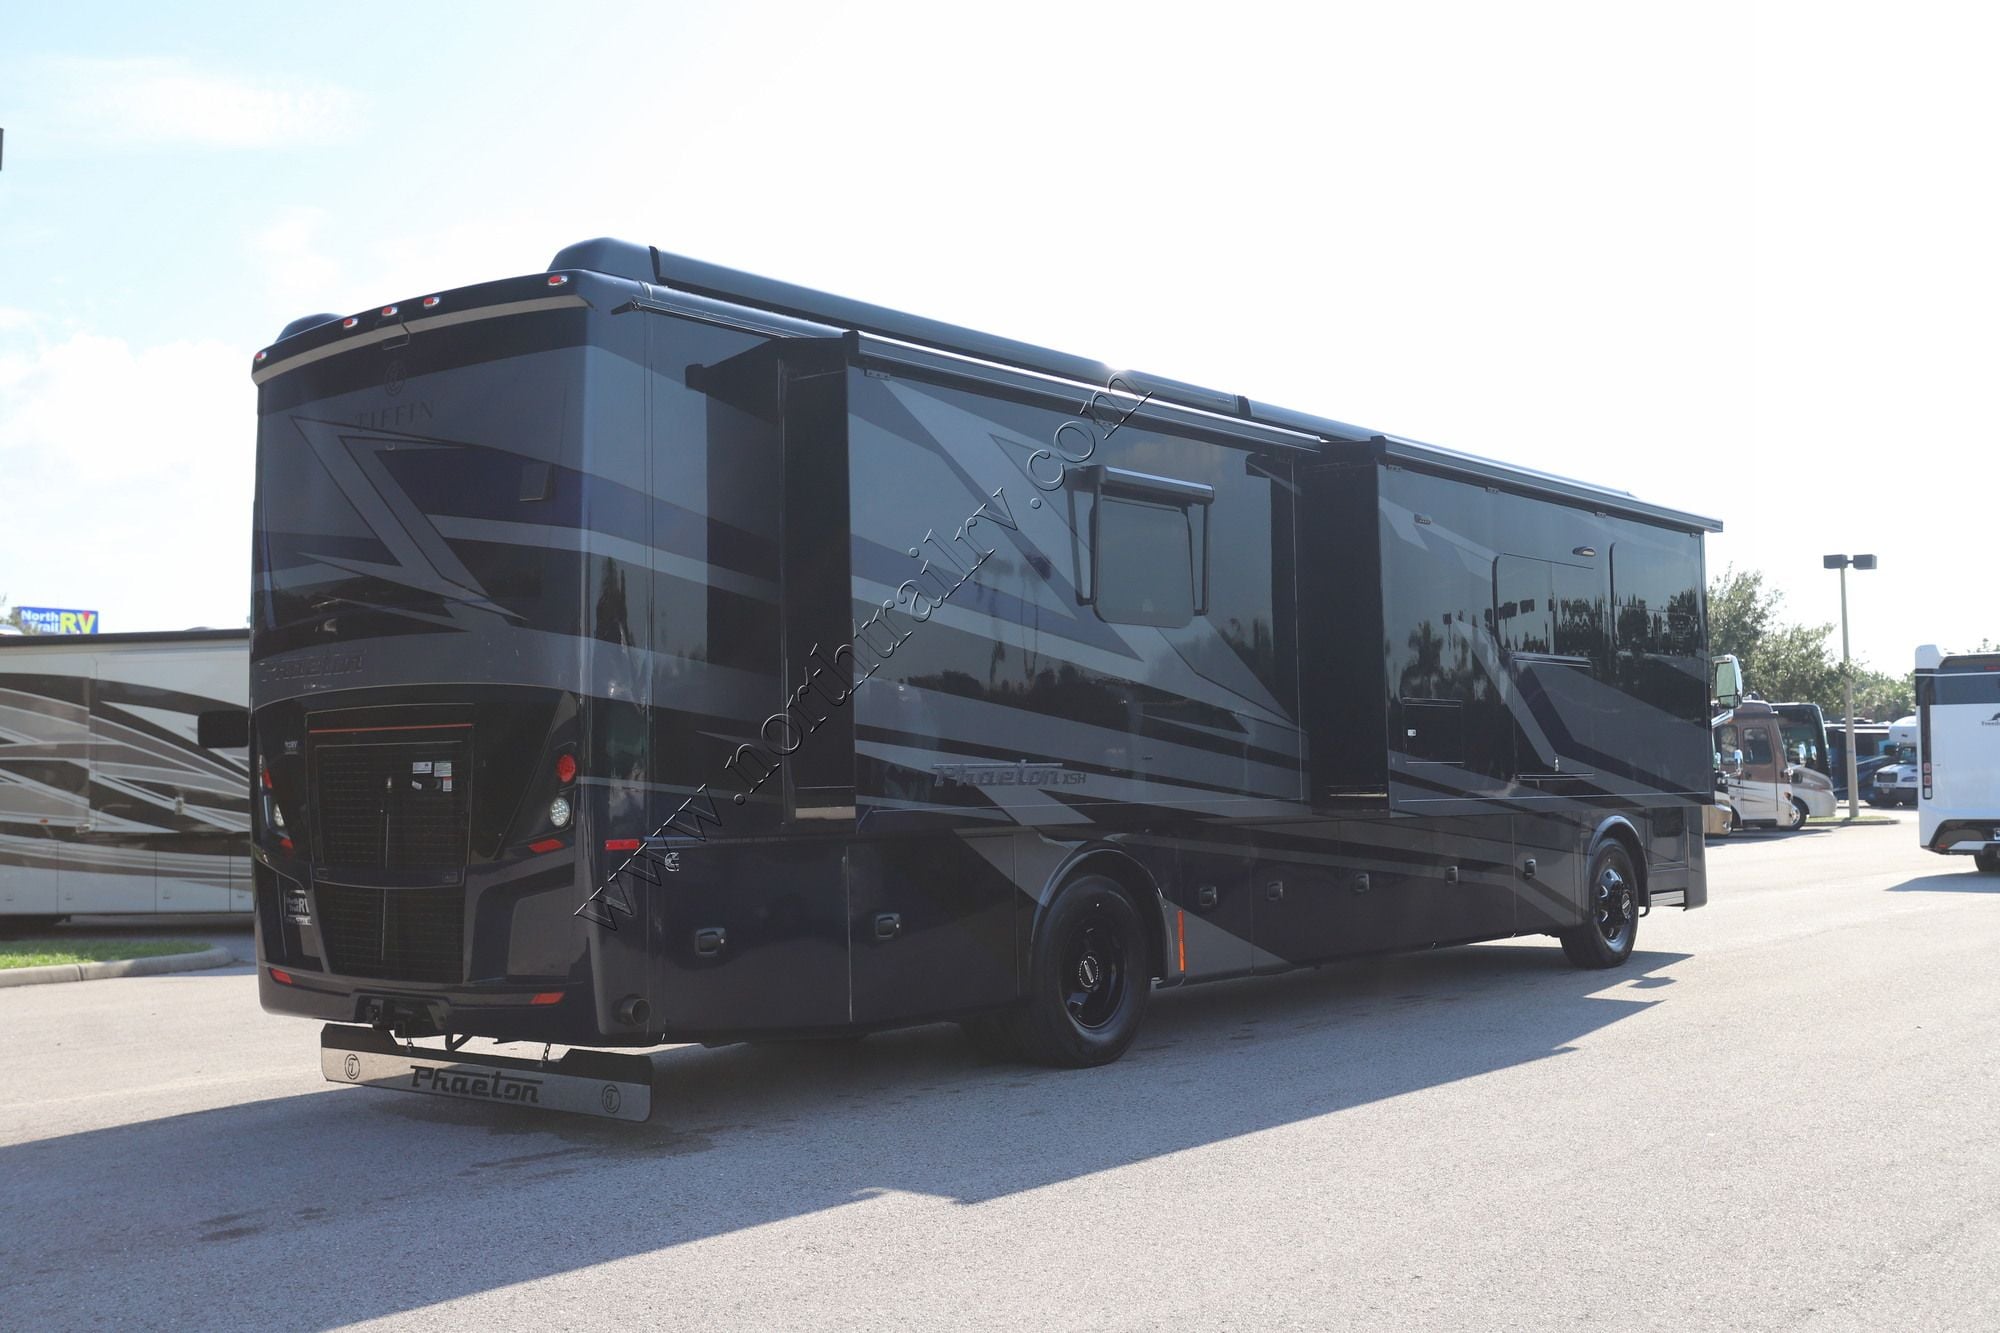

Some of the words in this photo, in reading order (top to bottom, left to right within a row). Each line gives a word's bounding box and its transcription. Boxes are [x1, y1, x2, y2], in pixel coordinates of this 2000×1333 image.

[355, 401, 432, 431] TIFFIN
[21, 610, 58, 621] North
[60, 611, 96, 634] RV
[31, 621, 59, 633] Trail
[932, 759, 1063, 786] Phaeton
[410, 1065, 543, 1103] Phaeton
